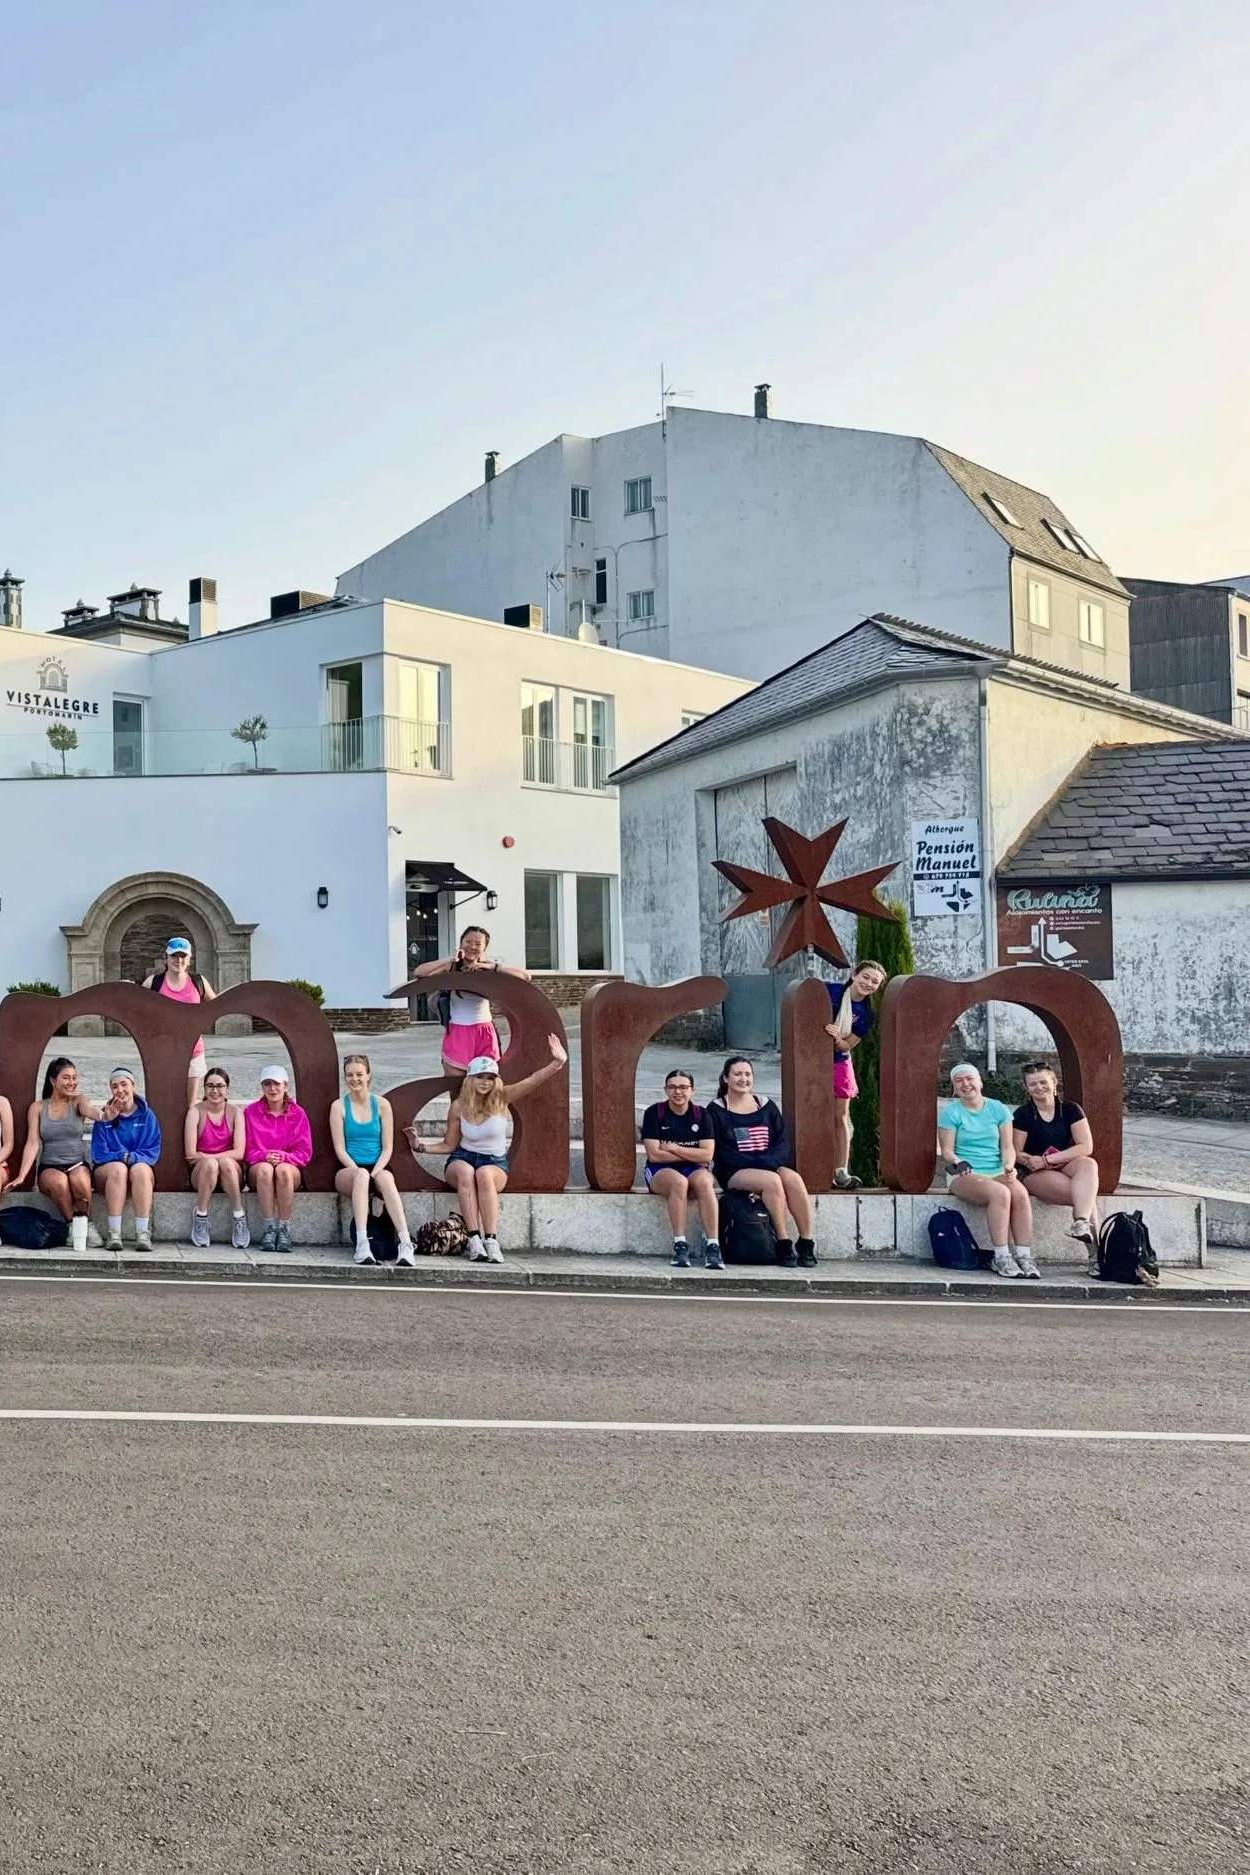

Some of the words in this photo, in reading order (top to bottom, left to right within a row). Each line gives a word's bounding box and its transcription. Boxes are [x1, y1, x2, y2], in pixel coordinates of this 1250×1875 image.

[40, 656, 67, 672] HOTEL
[6, 690, 99, 715] VISTALEGRE
[925, 824, 964, 835] Albergue
[916, 839, 974, 855] Pensión
[915, 854, 976, 871] Manuel
[1005, 908, 1054, 918] Alojamientos
[1071, 907, 1103, 915] encanto
